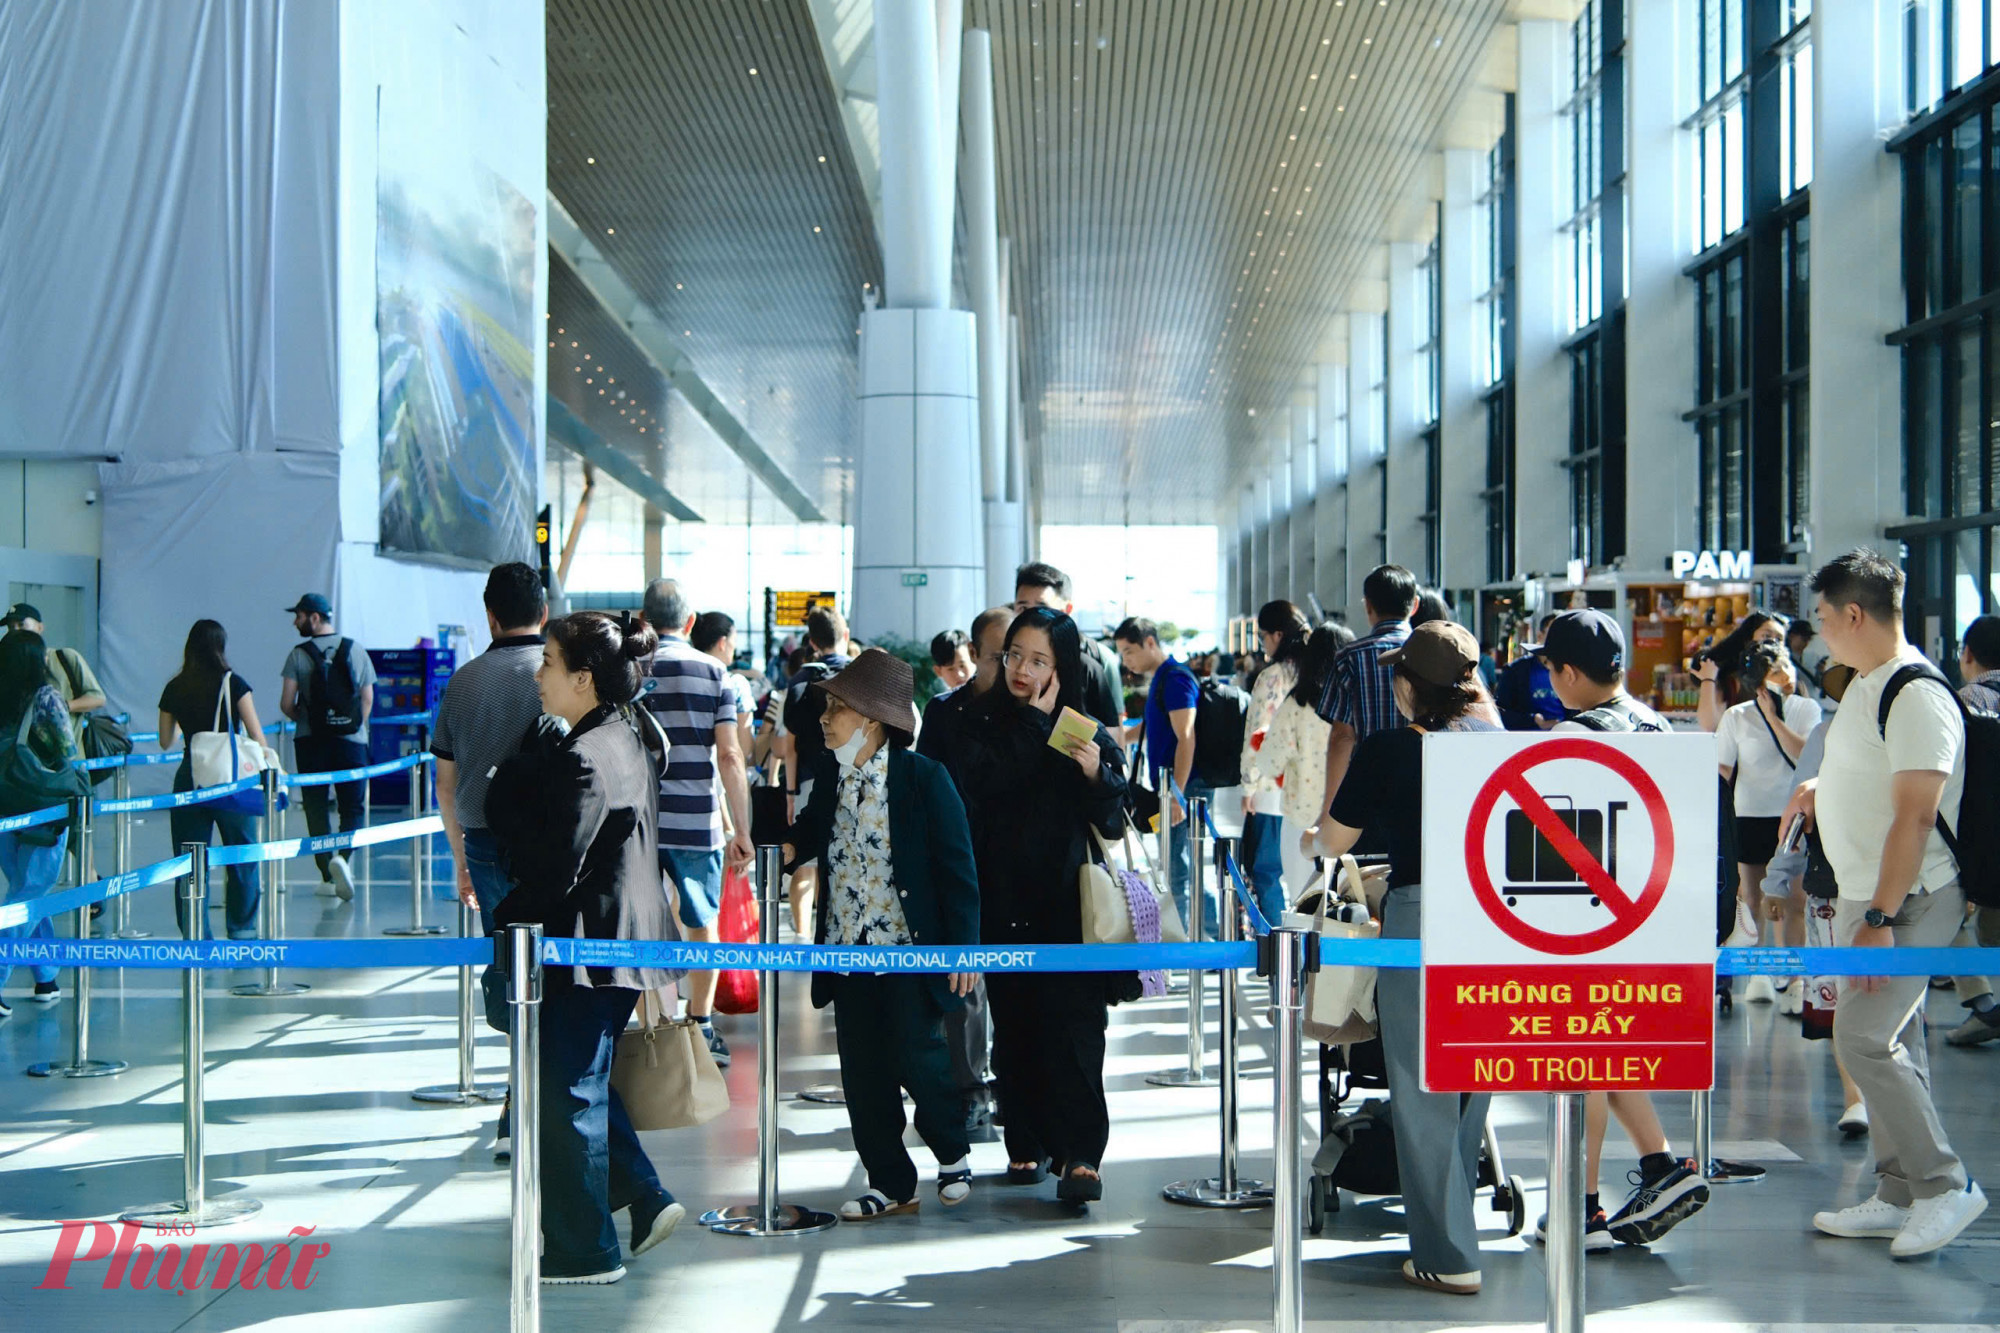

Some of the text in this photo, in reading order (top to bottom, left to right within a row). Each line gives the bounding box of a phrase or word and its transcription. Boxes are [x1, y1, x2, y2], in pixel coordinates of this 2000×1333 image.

[1673, 550, 1752, 579] PAM
[13, 943, 59, 959] NHAT
[66, 944, 204, 961] INTERNATIONAL
[209, 945, 288, 961] AIRPORT
[674, 948, 708, 964] TAN
[713, 949, 751, 965] SON
[757, 950, 806, 966] NHAT
[811, 951, 951, 968] INTERNATIONAL
[956, 951, 1037, 967] AIRPORT
[1456, 979, 1683, 1004] KHÔNG DÙNG
[1508, 1007, 1635, 1035] XE ĐẨY
[1474, 1057, 1662, 1082] NO TROLLEY
